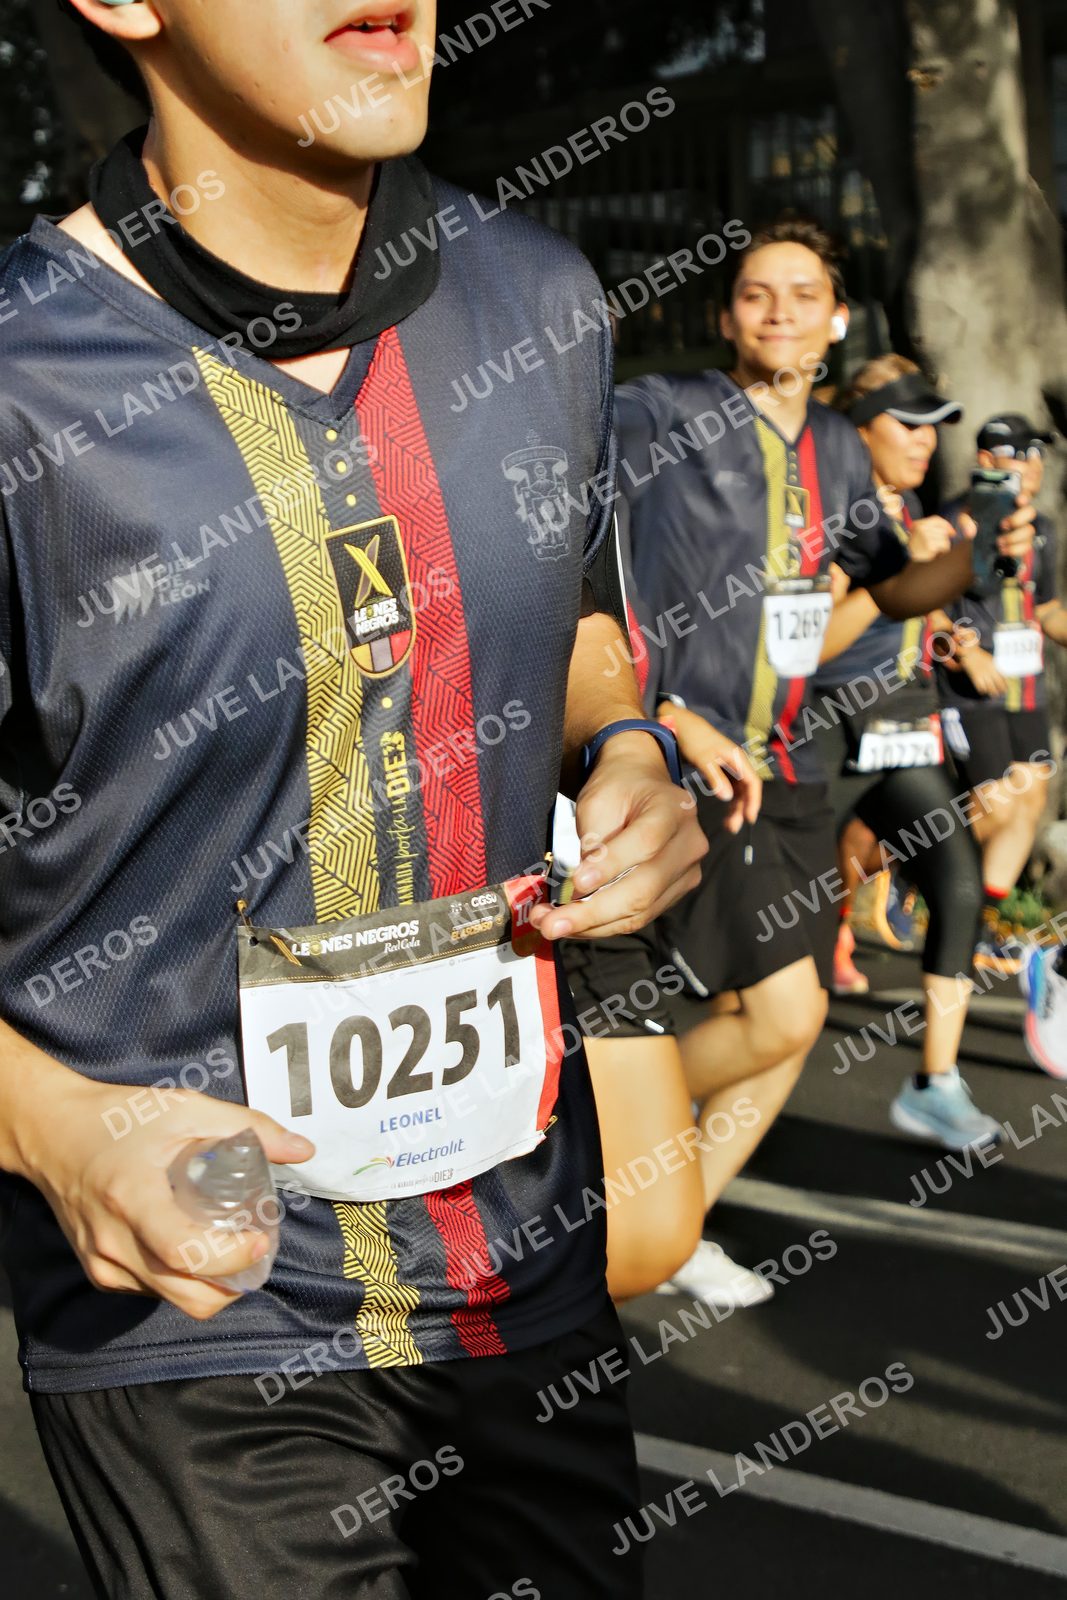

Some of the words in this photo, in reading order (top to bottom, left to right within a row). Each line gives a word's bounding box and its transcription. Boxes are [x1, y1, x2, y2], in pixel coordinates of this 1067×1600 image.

[356, 611, 399, 636] NEGROS
[355, 920, 419, 947] NEGROS
[266, 976, 520, 1118] 10251
[380, 1107, 442, 1133] LEONEL
[396, 1138, 464, 1168] Electrolit
